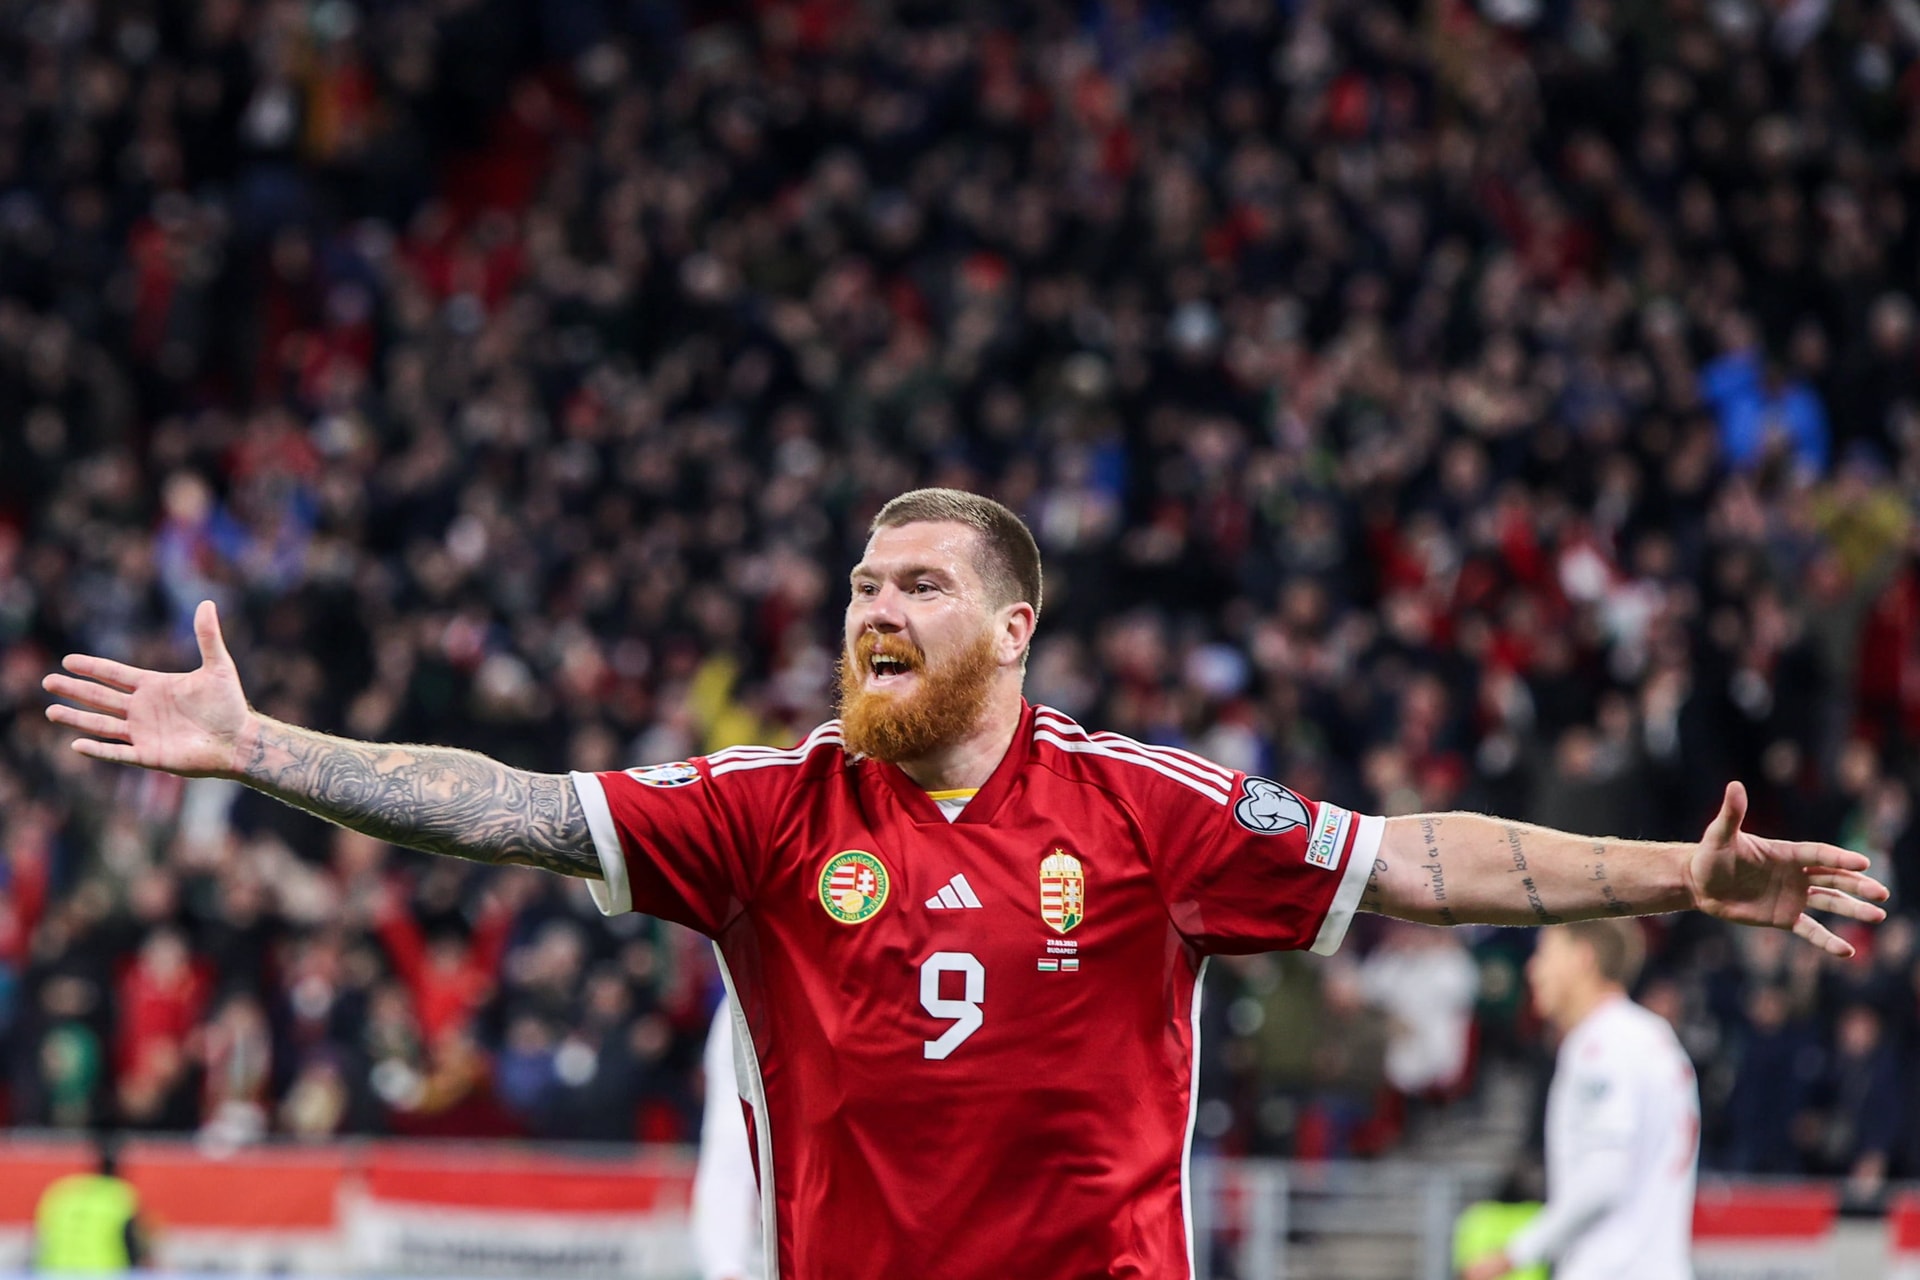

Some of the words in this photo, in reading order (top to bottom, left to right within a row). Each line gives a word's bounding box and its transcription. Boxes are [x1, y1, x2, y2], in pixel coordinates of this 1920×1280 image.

[1308, 840, 1320, 861] UEFA
[1046, 946, 1077, 955] BUDAPEST
[920, 951, 985, 1060] 9
